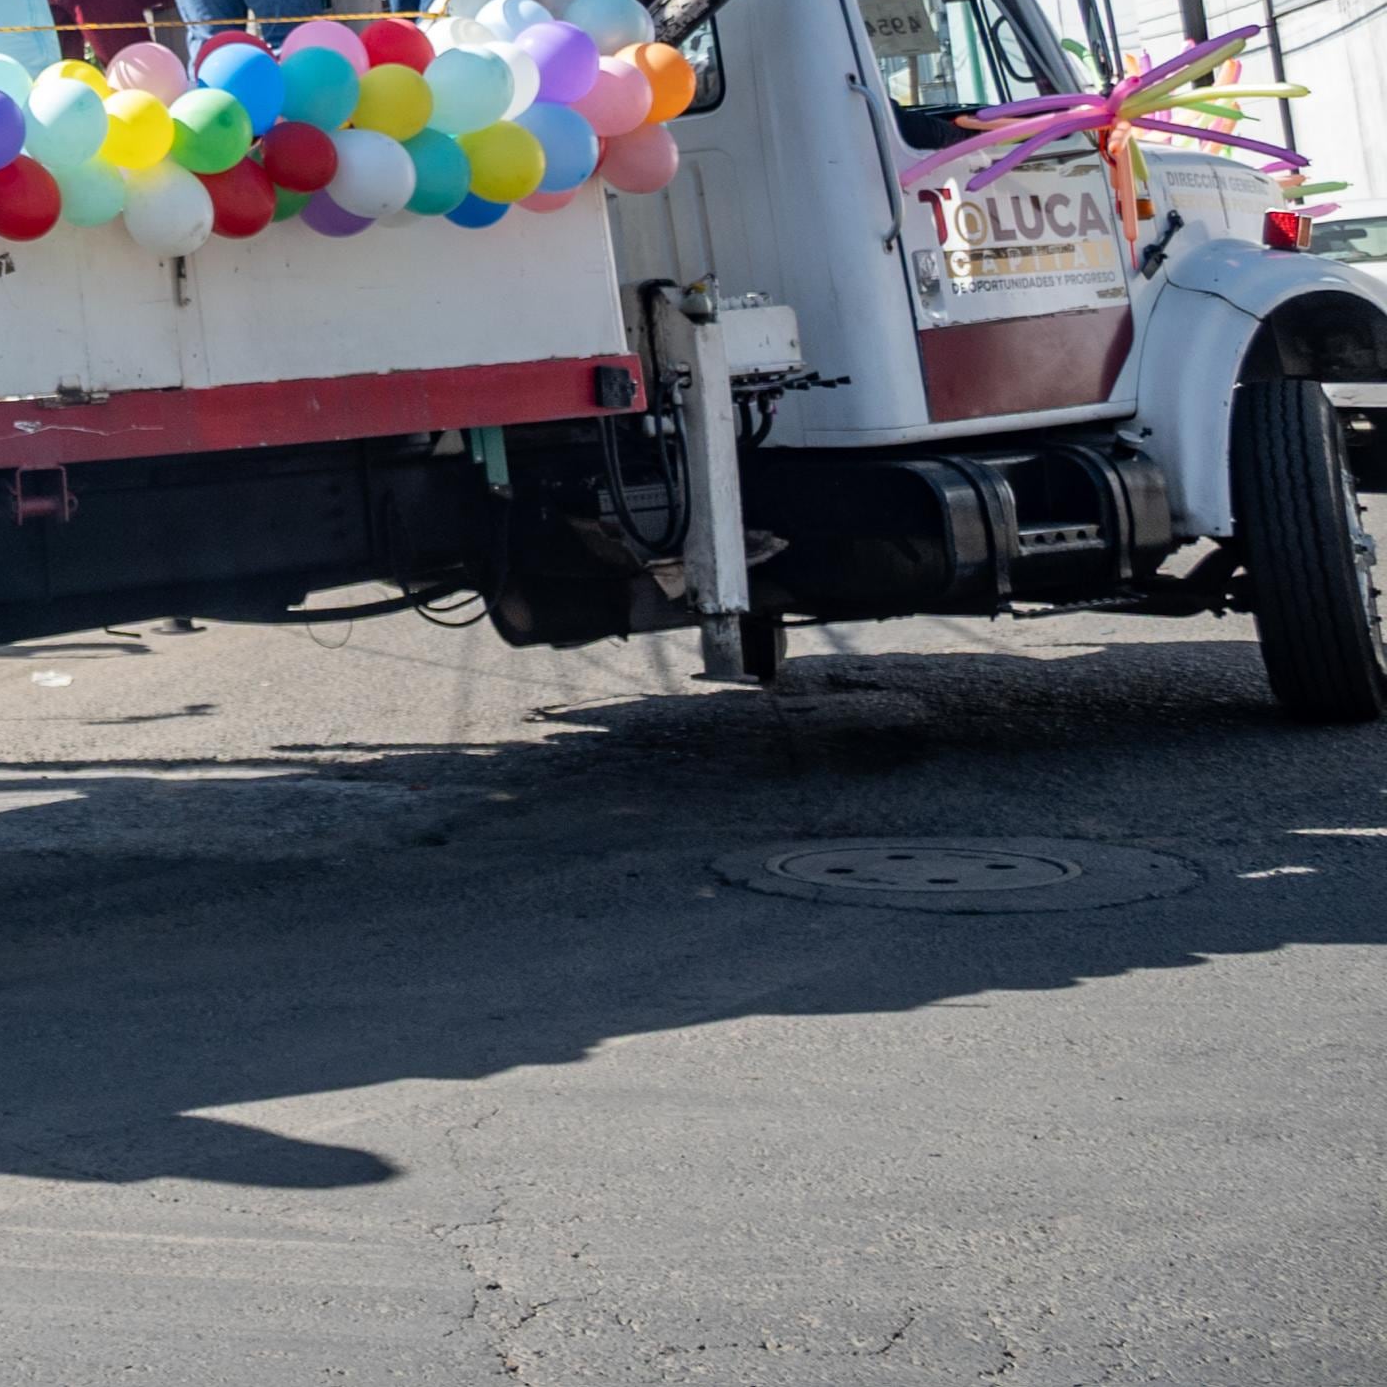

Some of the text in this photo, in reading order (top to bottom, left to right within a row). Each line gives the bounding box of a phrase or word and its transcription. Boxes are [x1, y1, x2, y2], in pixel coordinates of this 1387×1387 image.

[918, 187, 1110, 246] TOLUCA
[969, 275, 1055, 294] OPORTUNIDADES
[1056, 275, 1063, 286] Y
[1064, 271, 1116, 285] PROGRESO
